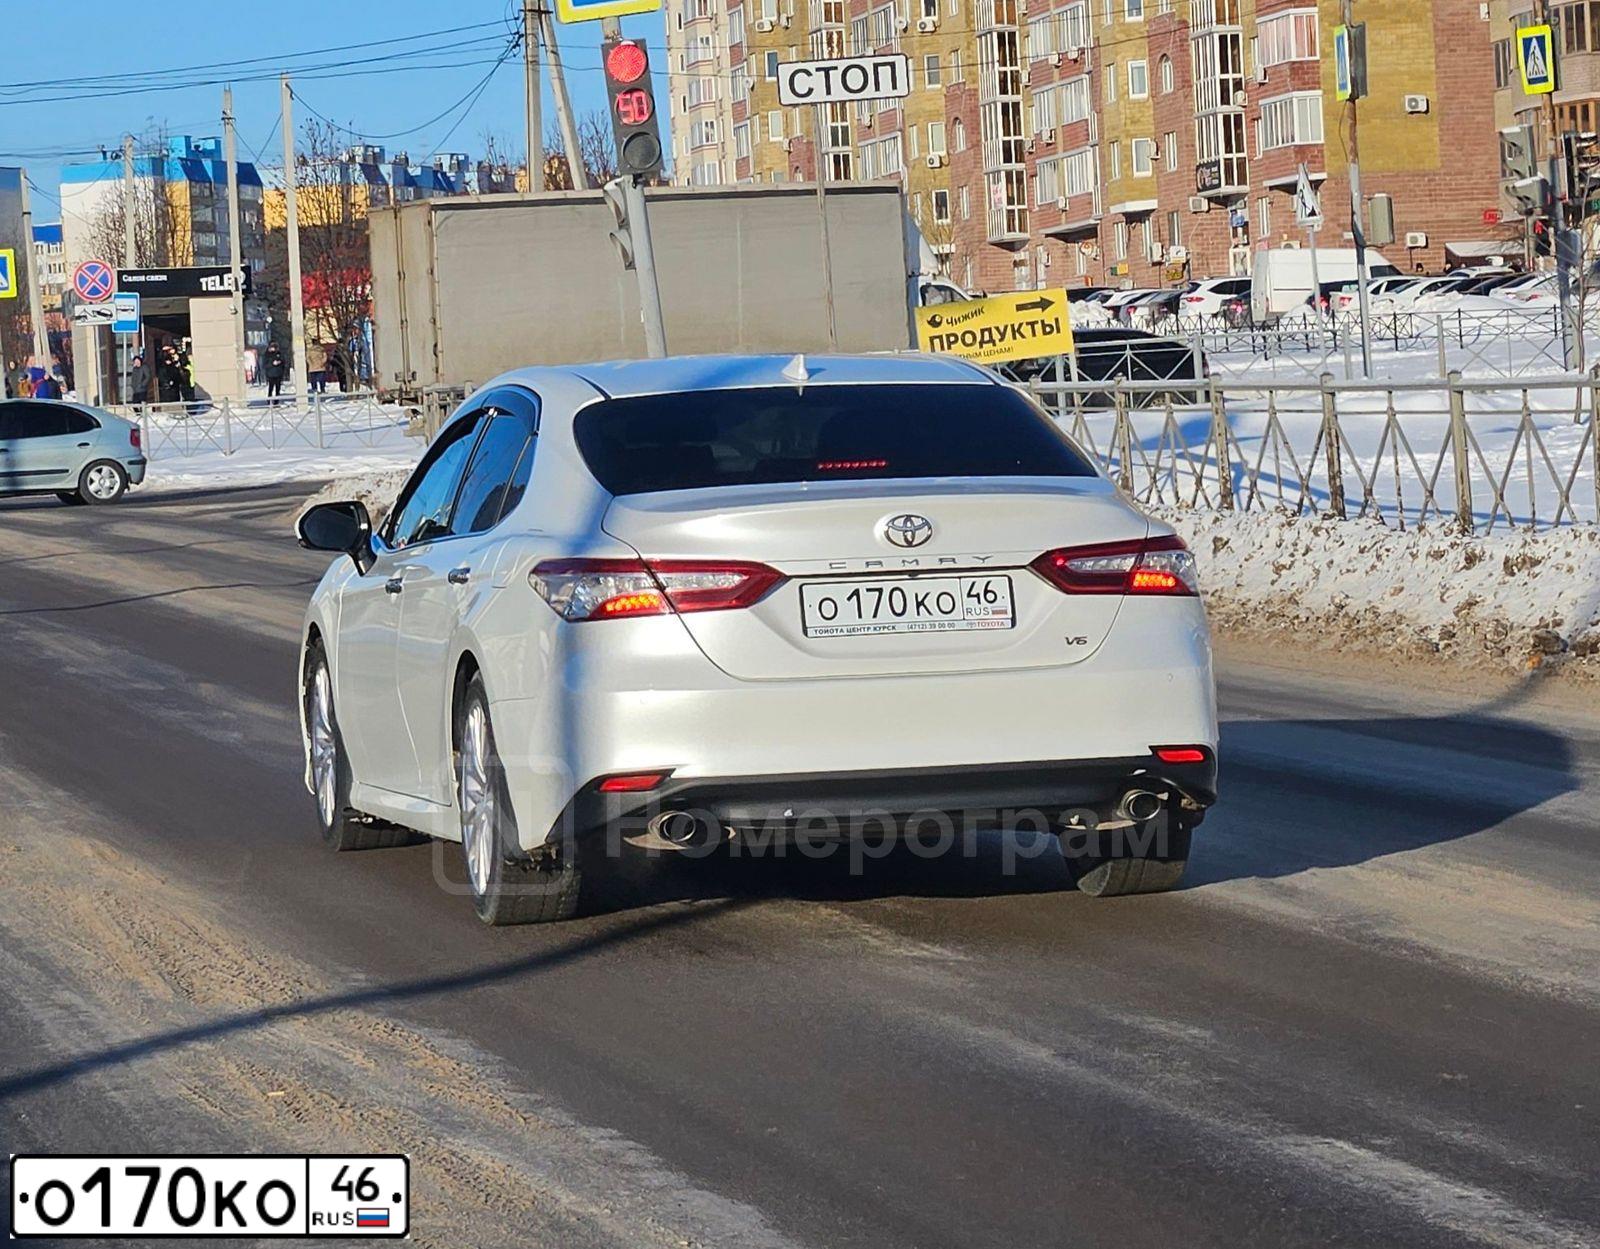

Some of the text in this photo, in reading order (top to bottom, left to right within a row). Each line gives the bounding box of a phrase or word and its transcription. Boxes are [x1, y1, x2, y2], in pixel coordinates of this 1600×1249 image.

[788, 61, 898, 99] СТОП
[928, 317, 1061, 353] ПРОДУКТЫ
[828, 554, 994, 570] CAMRY
[966, 580, 998, 605] 46
[966, 606, 990, 616] RUS
[846, 625, 872, 634] ЦЕНТР
[872, 624, 897, 632] КУРСК
[977, 620, 1005, 628] TOYOTA
[1064, 635, 1088, 646] V6
